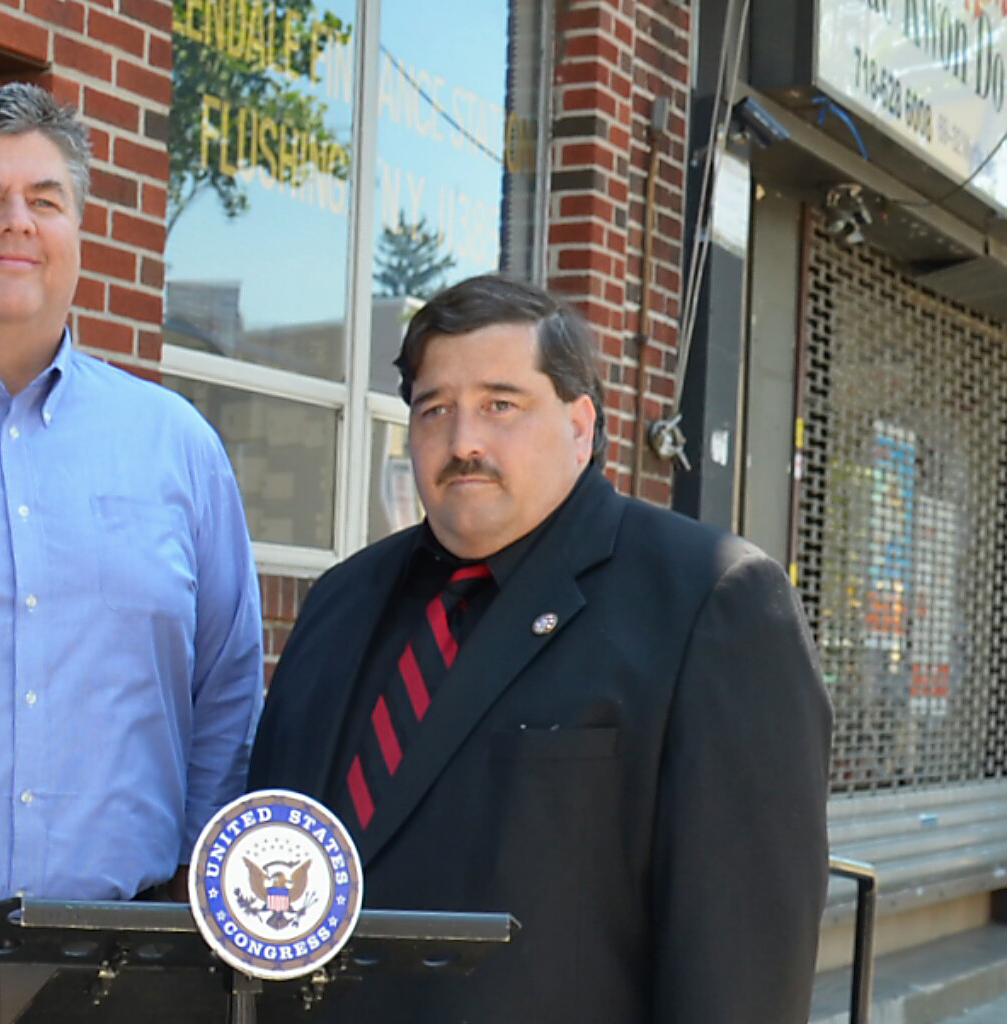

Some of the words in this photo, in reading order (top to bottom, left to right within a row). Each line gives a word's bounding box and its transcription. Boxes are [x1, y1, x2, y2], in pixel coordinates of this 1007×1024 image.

[200, 94, 348, 214] FLUSHING
[206, 806, 273, 878] UNITED
[288, 809, 349, 886] STATES
[223, 921, 331, 961] CONGRESS
